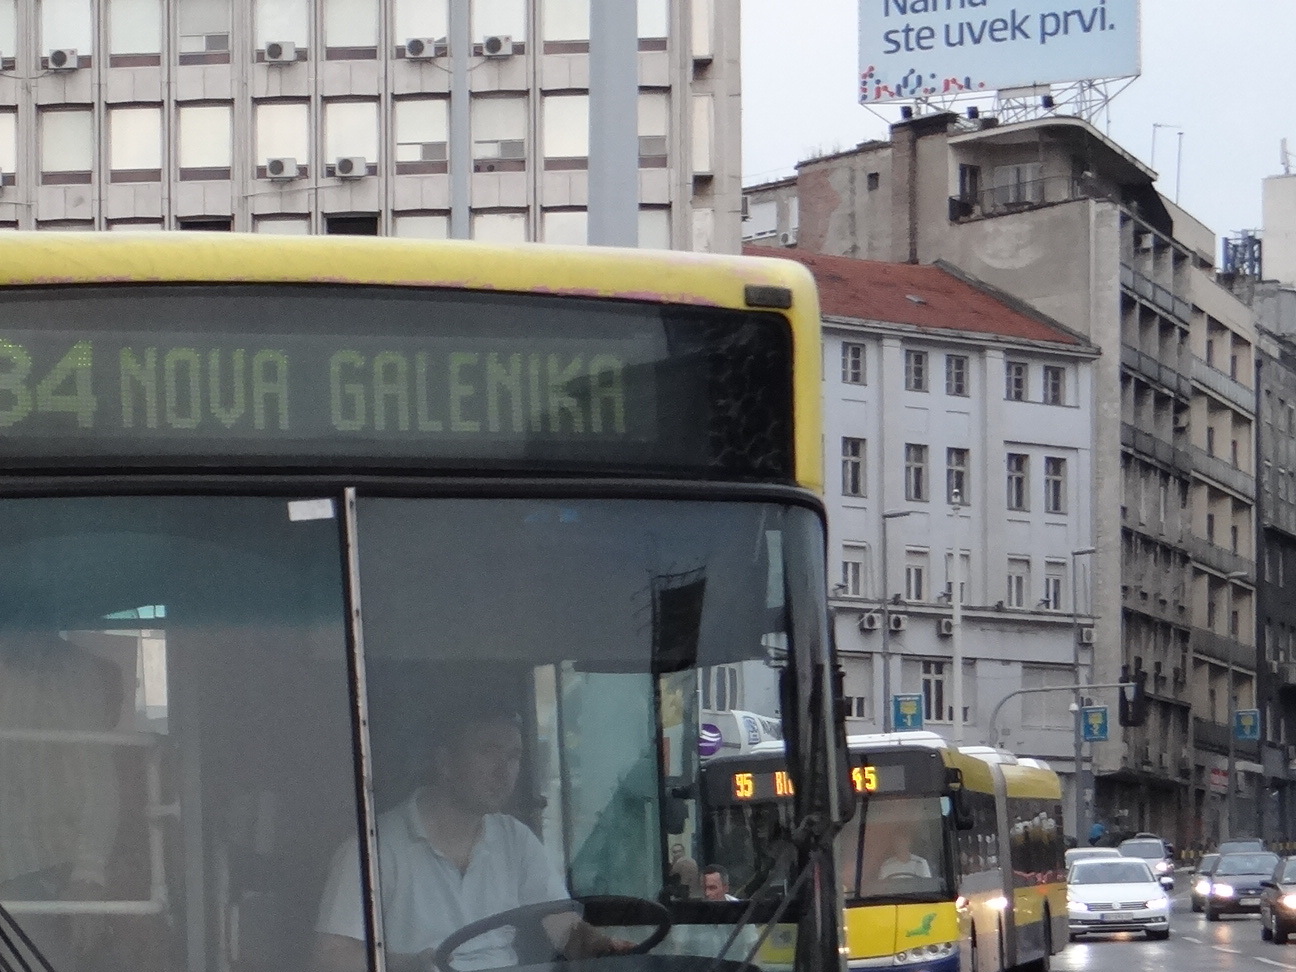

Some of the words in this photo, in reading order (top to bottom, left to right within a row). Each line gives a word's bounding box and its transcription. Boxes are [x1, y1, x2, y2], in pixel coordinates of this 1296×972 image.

[883, 23, 935, 54] ste
[944, 9, 1031, 47] uvek
[1039, 0, 1115, 44] prvi.
[119, 347, 290, 430] NOVA
[330, 349, 629, 433] GALENIKA
[735, 772, 754, 798] 95
